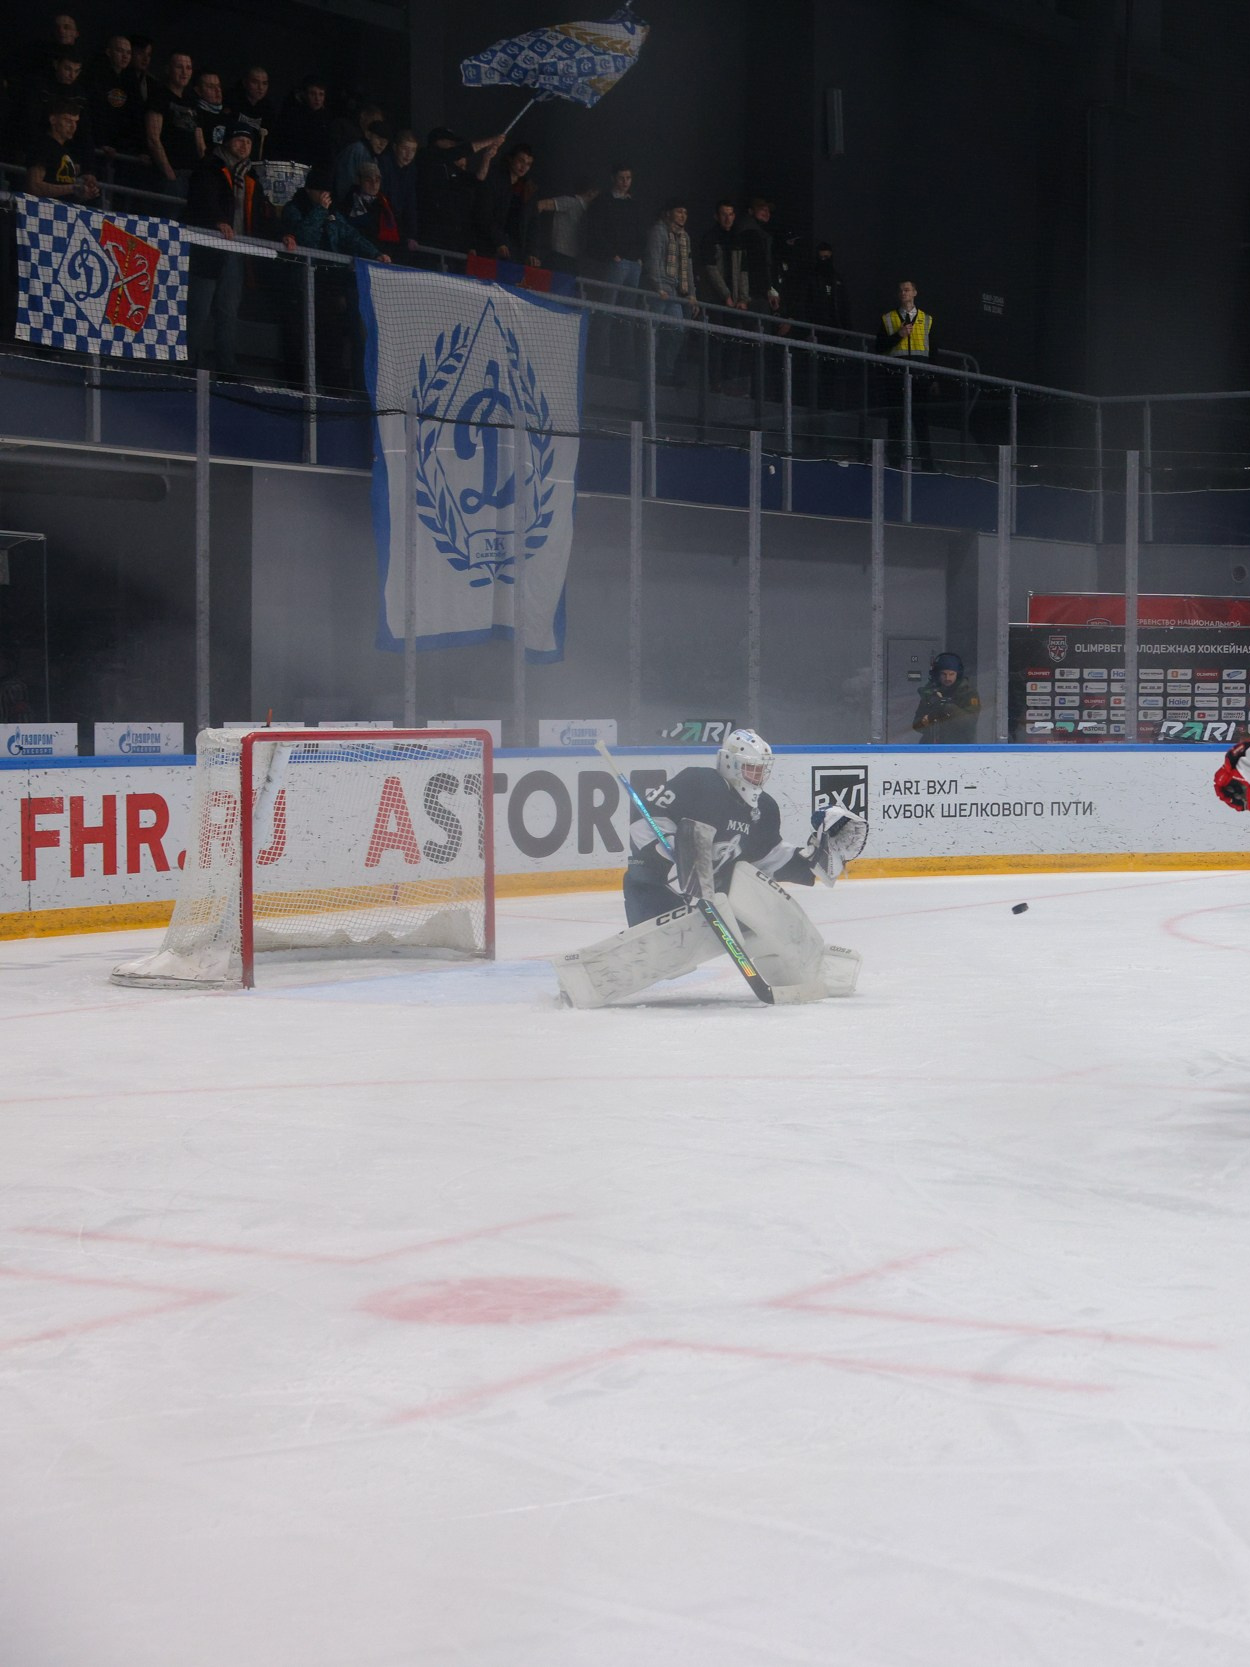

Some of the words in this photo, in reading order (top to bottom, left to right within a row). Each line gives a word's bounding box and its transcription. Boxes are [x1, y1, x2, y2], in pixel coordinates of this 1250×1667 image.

[1136, 618, 1176, 627] ЕРВЕНСТВО
[1075, 643, 1122, 654] OLIMPBET
[1124, 644, 1196, 655] ЛОДЕЖНАЯ
[1158, 721, 1236, 741] PARI
[21, 734, 53, 745] ГАЗПРОМ
[881, 780, 921, 795] PARI
[926, 780, 957, 794] ВХЛ
[645, 784, 676, 808] 82
[881, 802, 935, 820] КУБОК
[940, 801, 1045, 819] ШЕЛКОВОГО
[1050, 800, 1094, 817] ПУТИ
[726, 820, 751, 835] МХК
[755, 871, 791, 900] CCM
